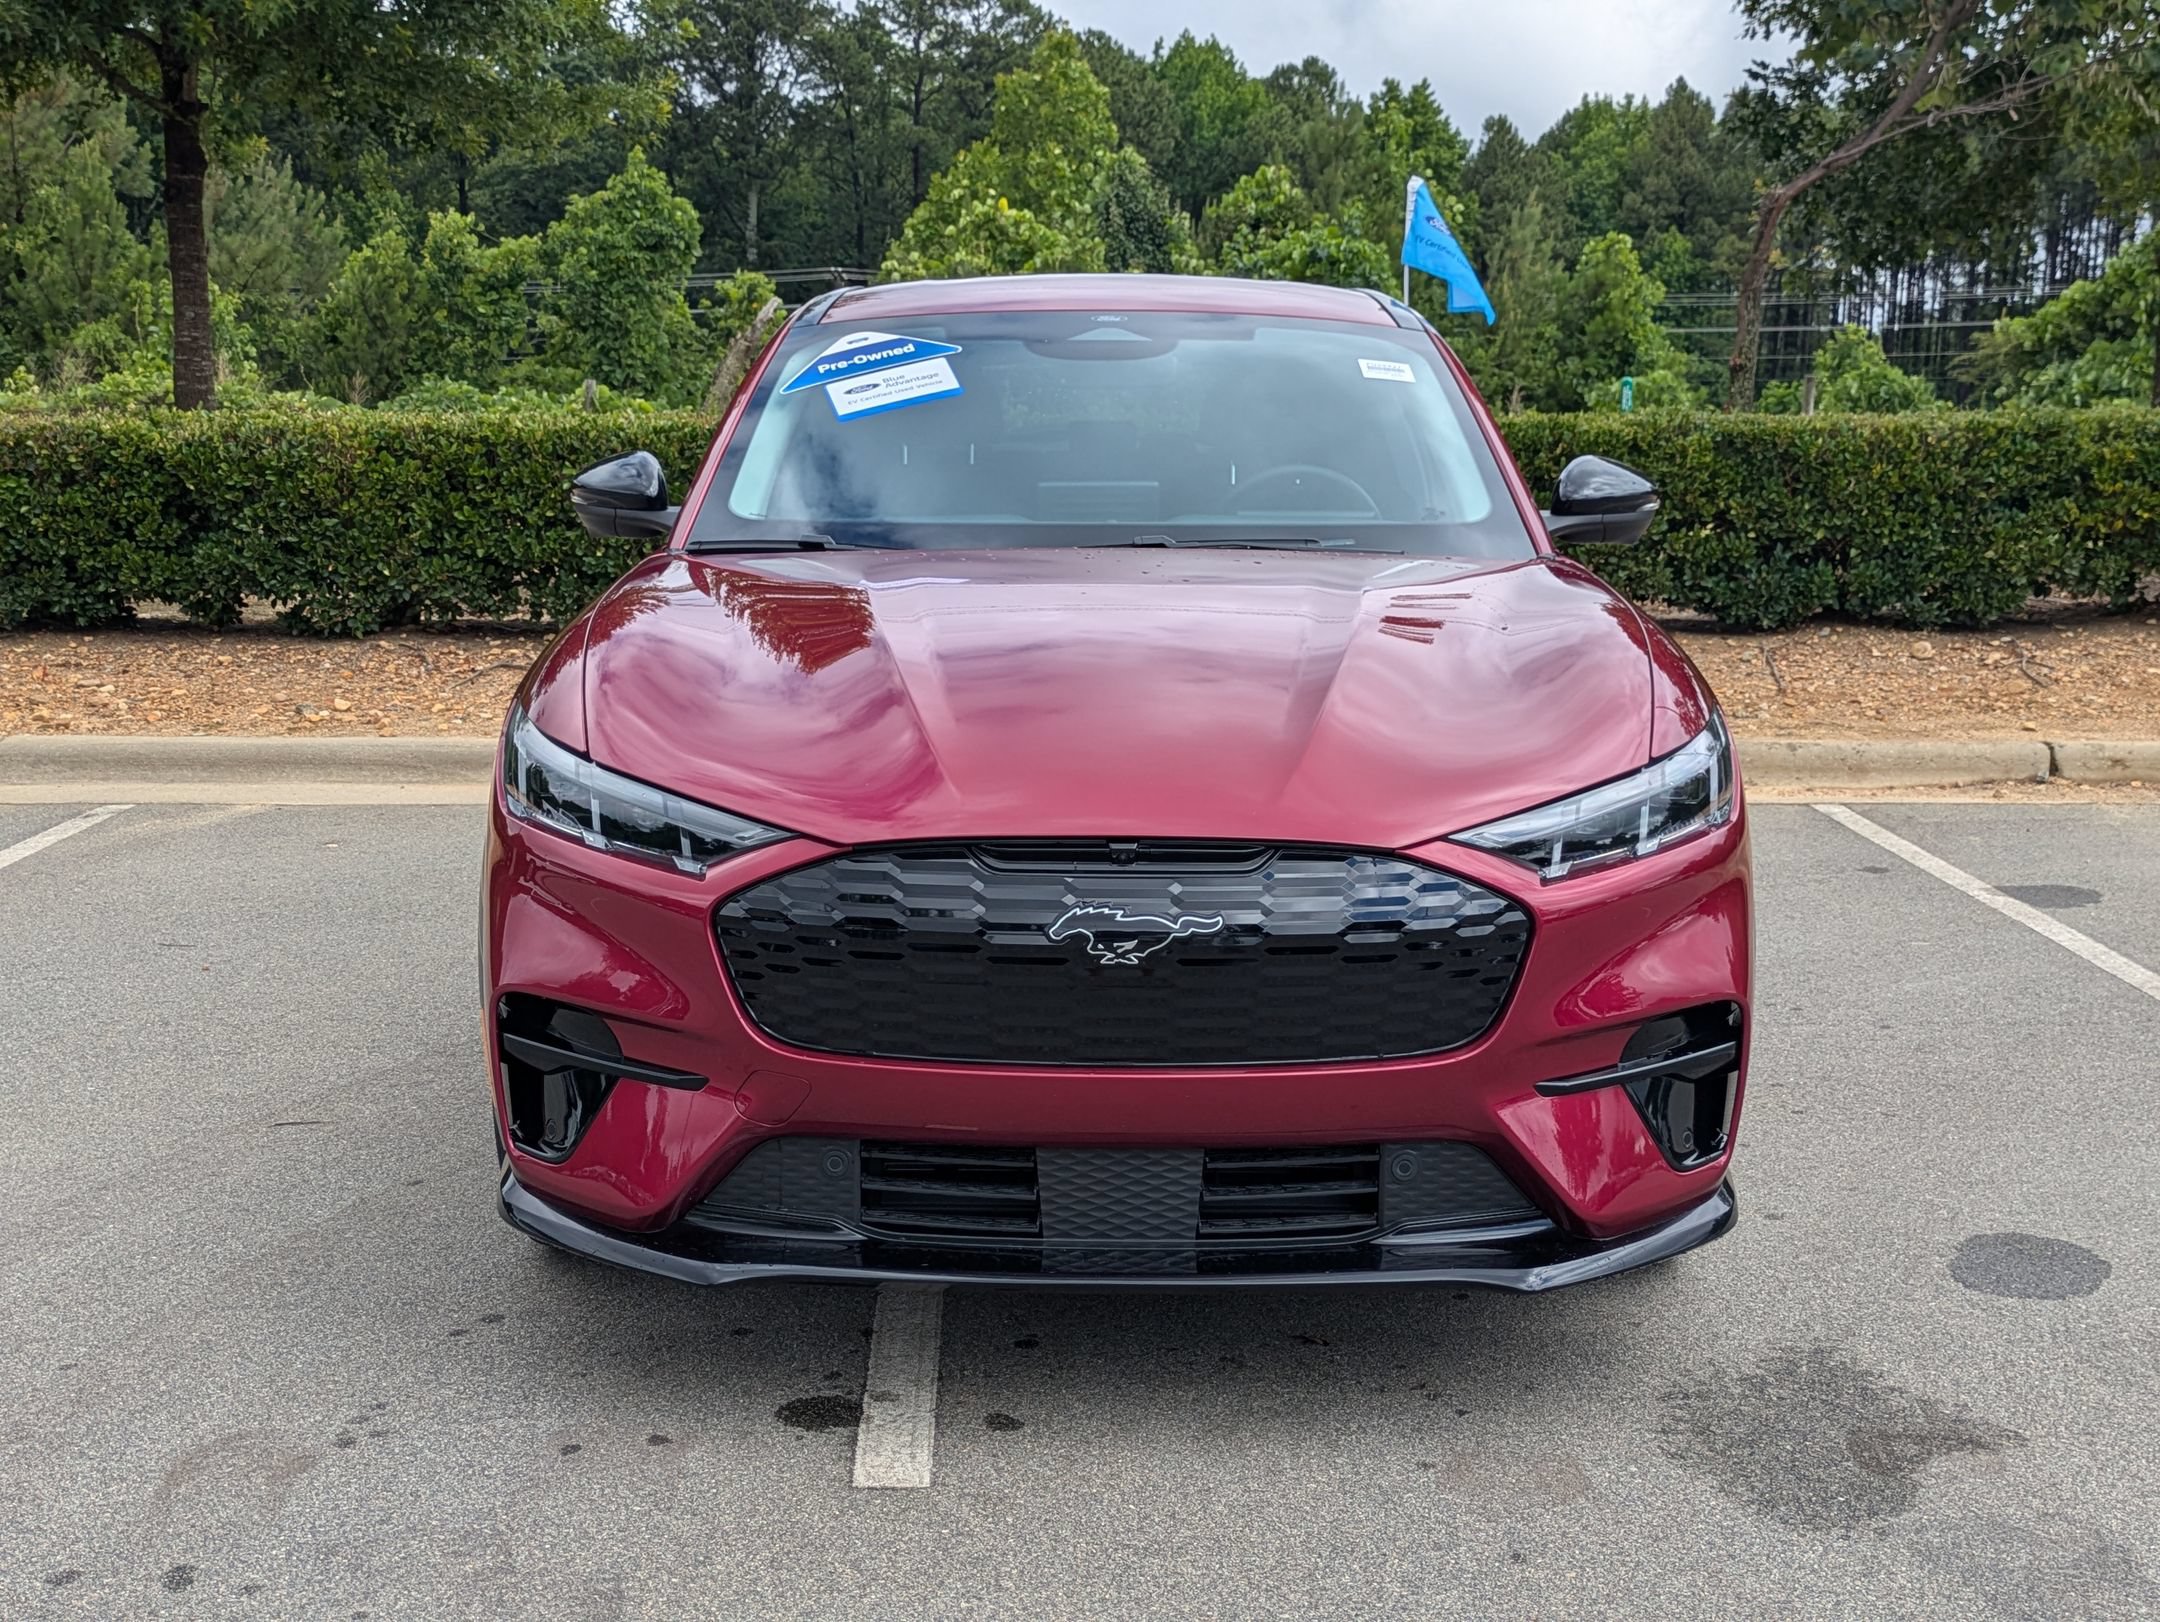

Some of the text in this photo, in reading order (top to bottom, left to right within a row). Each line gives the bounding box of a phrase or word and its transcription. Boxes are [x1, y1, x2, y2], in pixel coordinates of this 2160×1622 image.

[818, 343, 915, 374] Pre-Owned
[882, 375, 905, 385] Blue
[885, 373, 940, 389] Advantage
